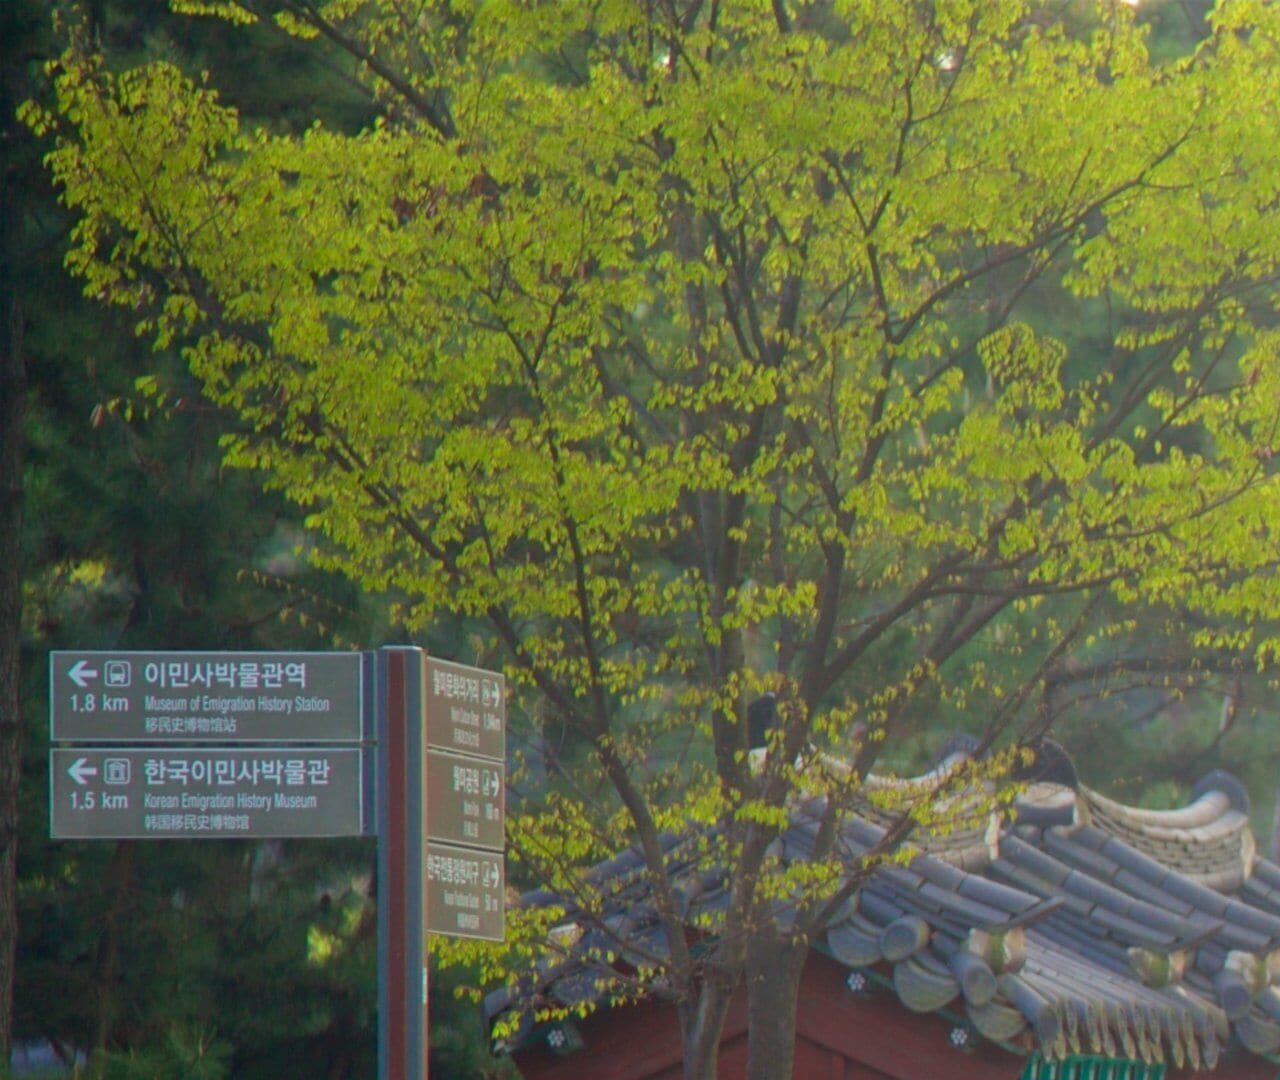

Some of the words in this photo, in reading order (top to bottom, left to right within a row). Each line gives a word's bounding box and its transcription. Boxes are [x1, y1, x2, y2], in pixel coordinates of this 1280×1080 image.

[145, 662, 306, 688] 이민사박물관역
[70, 693, 95, 712] 1.8
[103, 693, 129, 712] km
[145, 695, 187, 711] Museum
[190, 695, 200, 711] of
[203, 695, 255, 714] Emigration
[258, 695, 293, 715] History
[295, 695, 330, 711] Station
[144, 759, 330, 785] 한국이민사박물관
[70, 791, 95, 809] 1.5
[102, 791, 128, 809] km
[145, 793, 179, 808] Korean
[182, 792, 234, 811] Emigration
[237, 792, 272, 812] History
[274, 793, 317, 808] Museum
